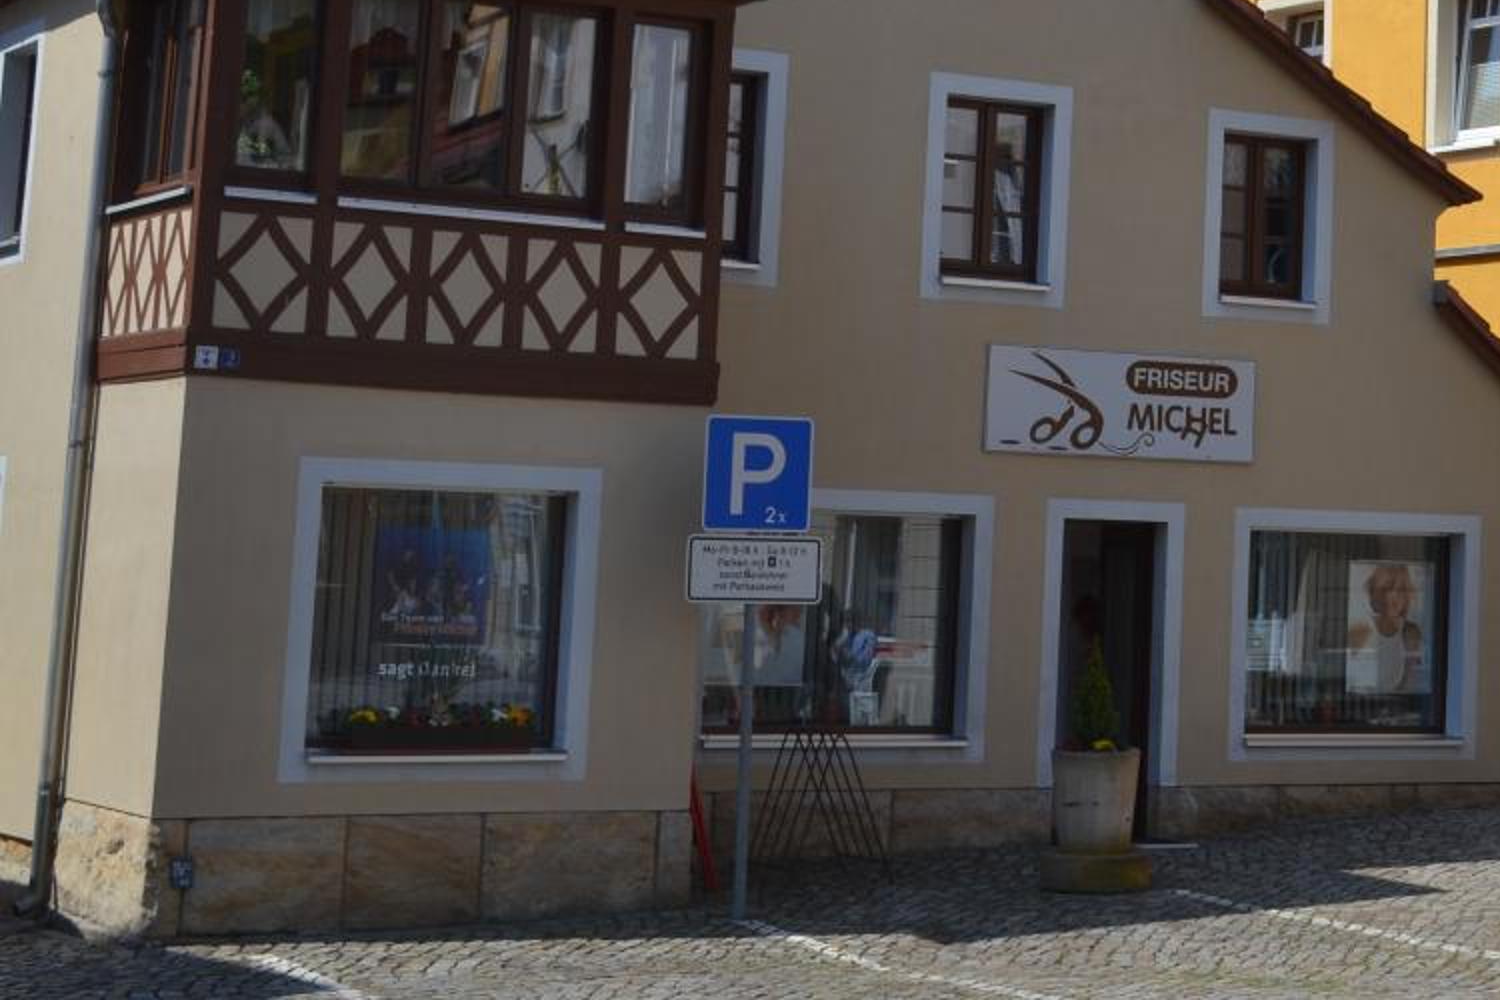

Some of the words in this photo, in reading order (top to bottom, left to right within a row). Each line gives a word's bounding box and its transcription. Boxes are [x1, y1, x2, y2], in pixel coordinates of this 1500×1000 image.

[1133, 367, 1230, 393] FRISEUR
[1126, 403, 1238, 448] MICHEL
[729, 432, 786, 516] P
[764, 506, 787, 524] 2x
[376, 661, 416, 680] sagt
